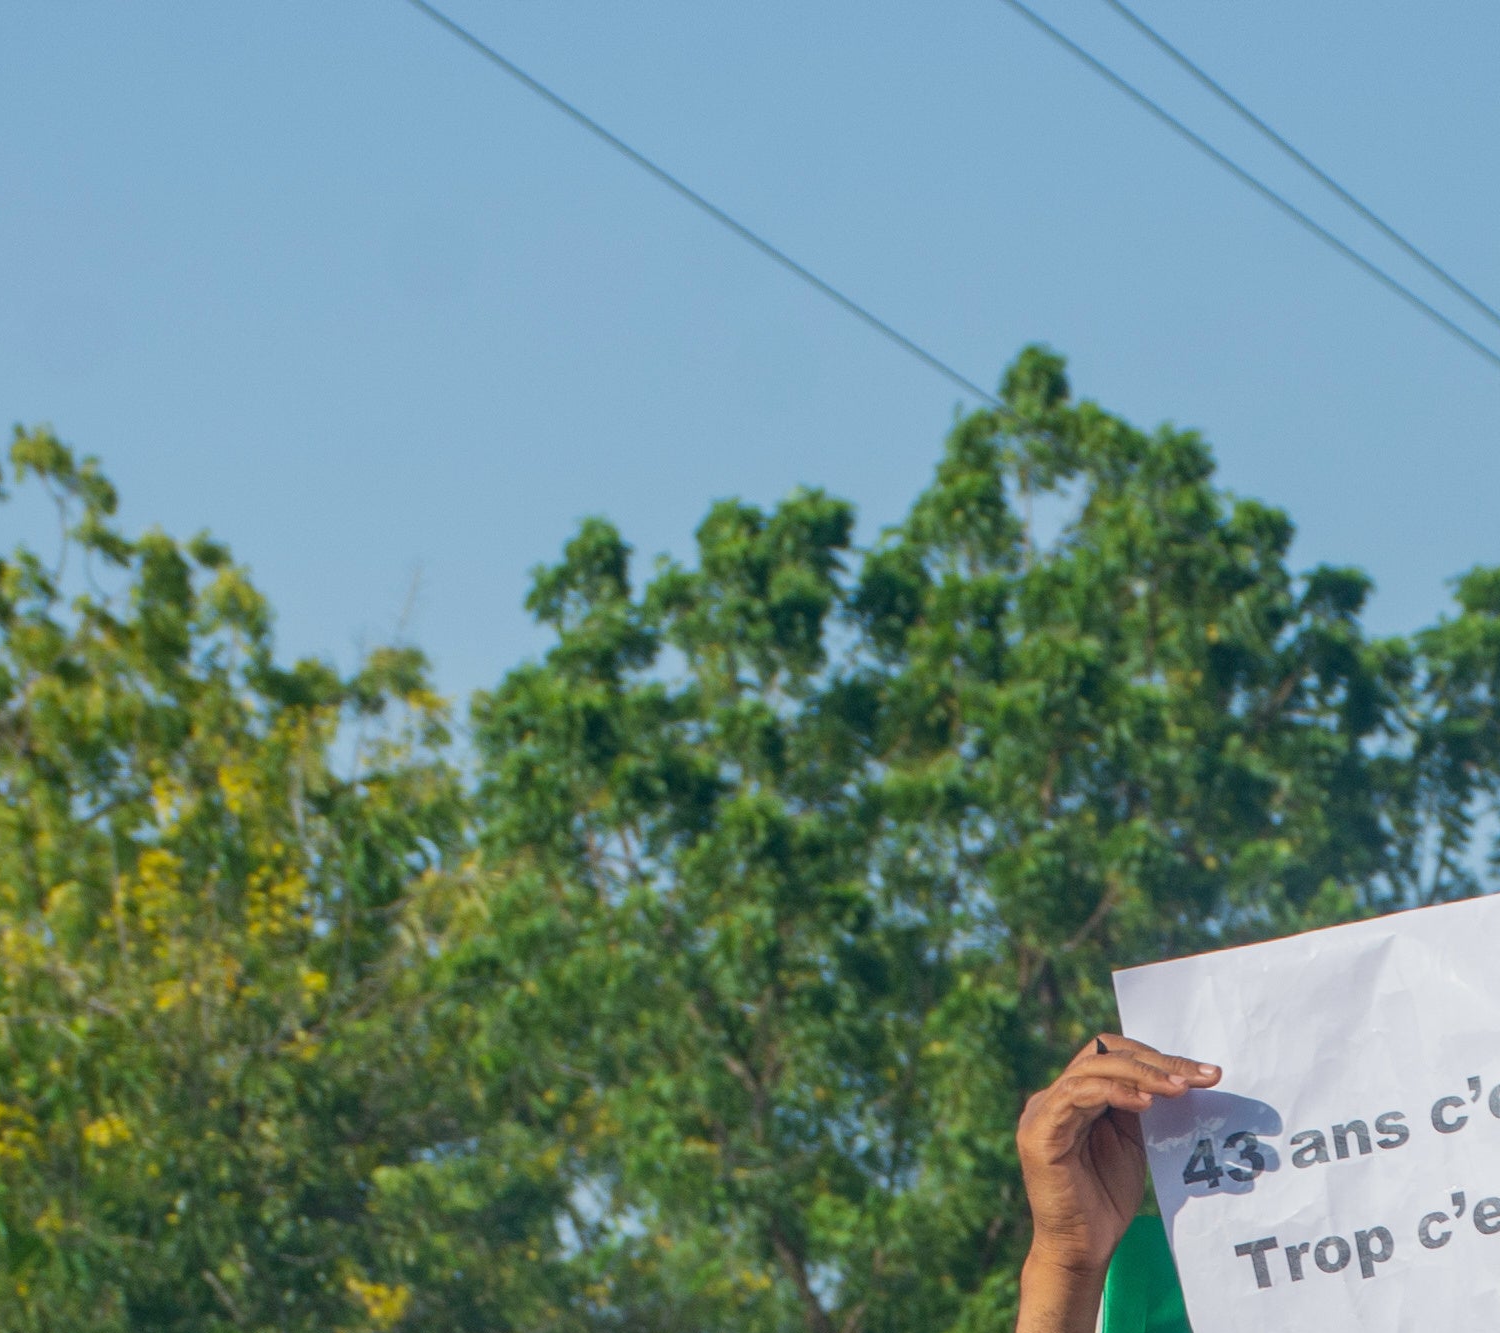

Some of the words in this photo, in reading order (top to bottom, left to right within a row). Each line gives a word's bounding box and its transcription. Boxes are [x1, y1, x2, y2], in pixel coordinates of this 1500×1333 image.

[1181, 1128, 1268, 1191] 43
[1288, 1110, 1411, 1171] ans
[1234, 1224, 1394, 1290] Trop
